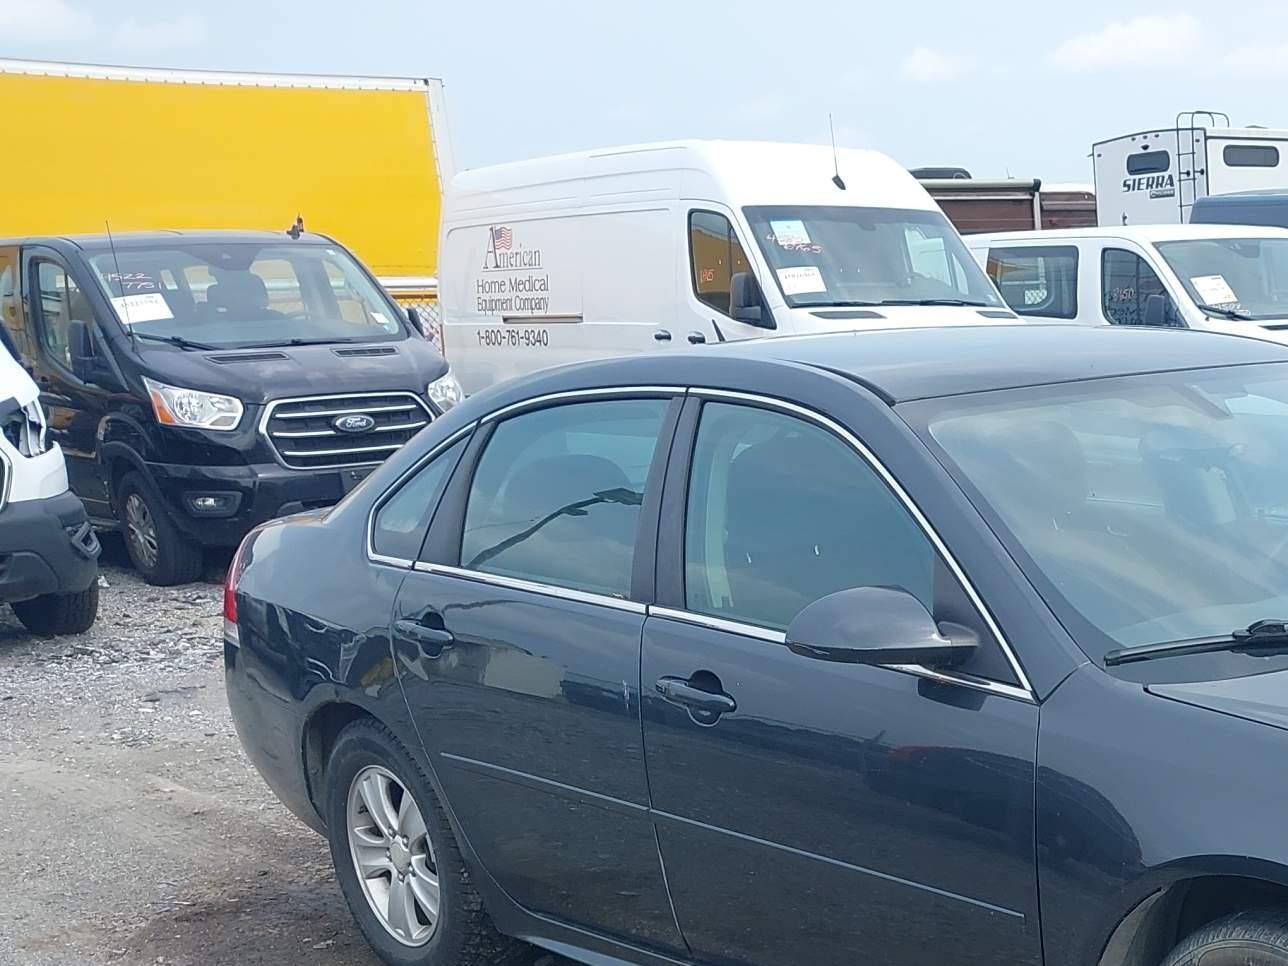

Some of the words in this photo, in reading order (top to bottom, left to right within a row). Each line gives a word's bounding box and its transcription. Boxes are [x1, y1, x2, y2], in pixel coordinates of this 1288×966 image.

[1122, 174, 1174, 192] SIERRA
[482, 226, 541, 270] American
[476, 280, 506, 295] Home
[508, 274, 549, 293] Medical
[477, 296, 513, 317] Equipment
[514, 295, 550, 315] Company
[477, 329, 549, 346] 1-800-761-9340
[345, 417, 367, 428] Ford
